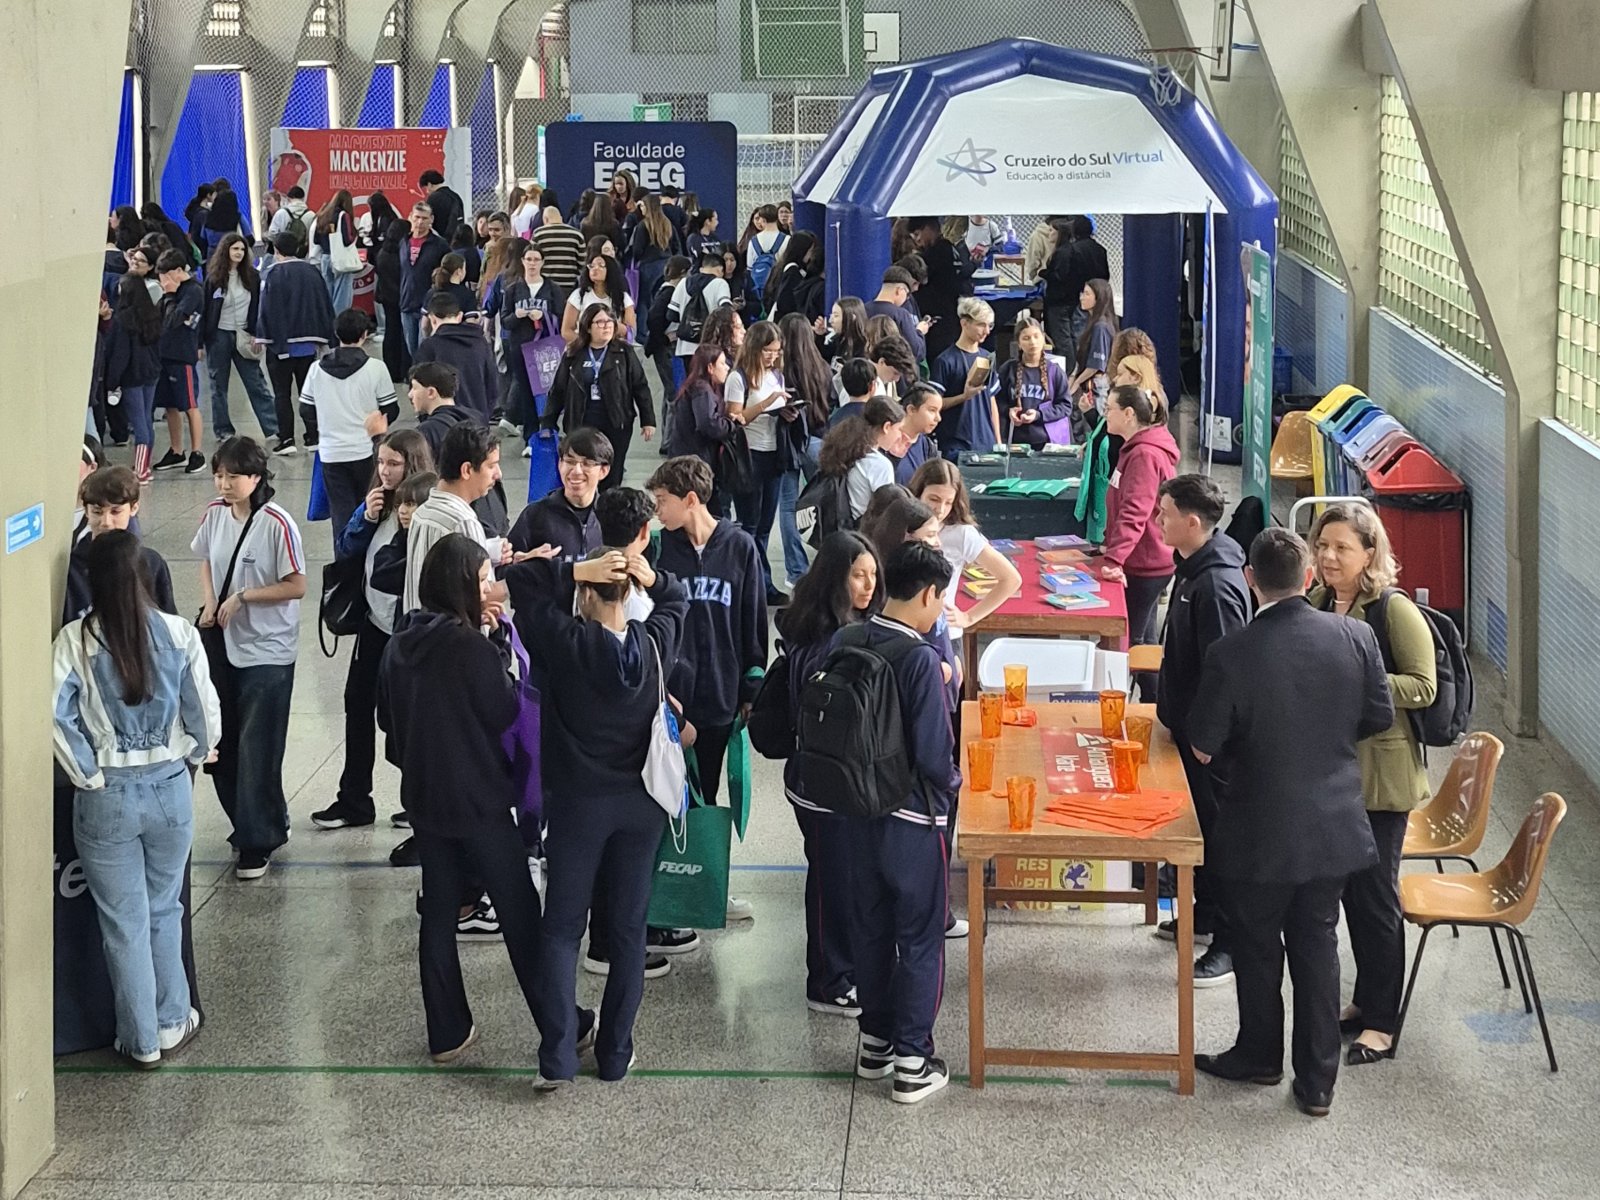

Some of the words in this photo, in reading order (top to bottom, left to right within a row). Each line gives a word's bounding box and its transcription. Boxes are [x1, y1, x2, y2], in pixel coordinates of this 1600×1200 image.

[593, 141, 685, 158] Faculdade
[329, 150, 407, 172] MACKENZIE
[1004, 154, 1067, 167] Cruzeiro
[1068, 153, 1087, 166] do
[1089, 152, 1112, 165] Sul
[1113, 150, 1164, 164] Virtual
[1006, 171, 1055, 182] Educação
[1066, 170, 1111, 180] distância
[681, 576, 732, 607] AZZA
[658, 860, 703, 875] FECAP
[1016, 858, 1049, 871] RES
